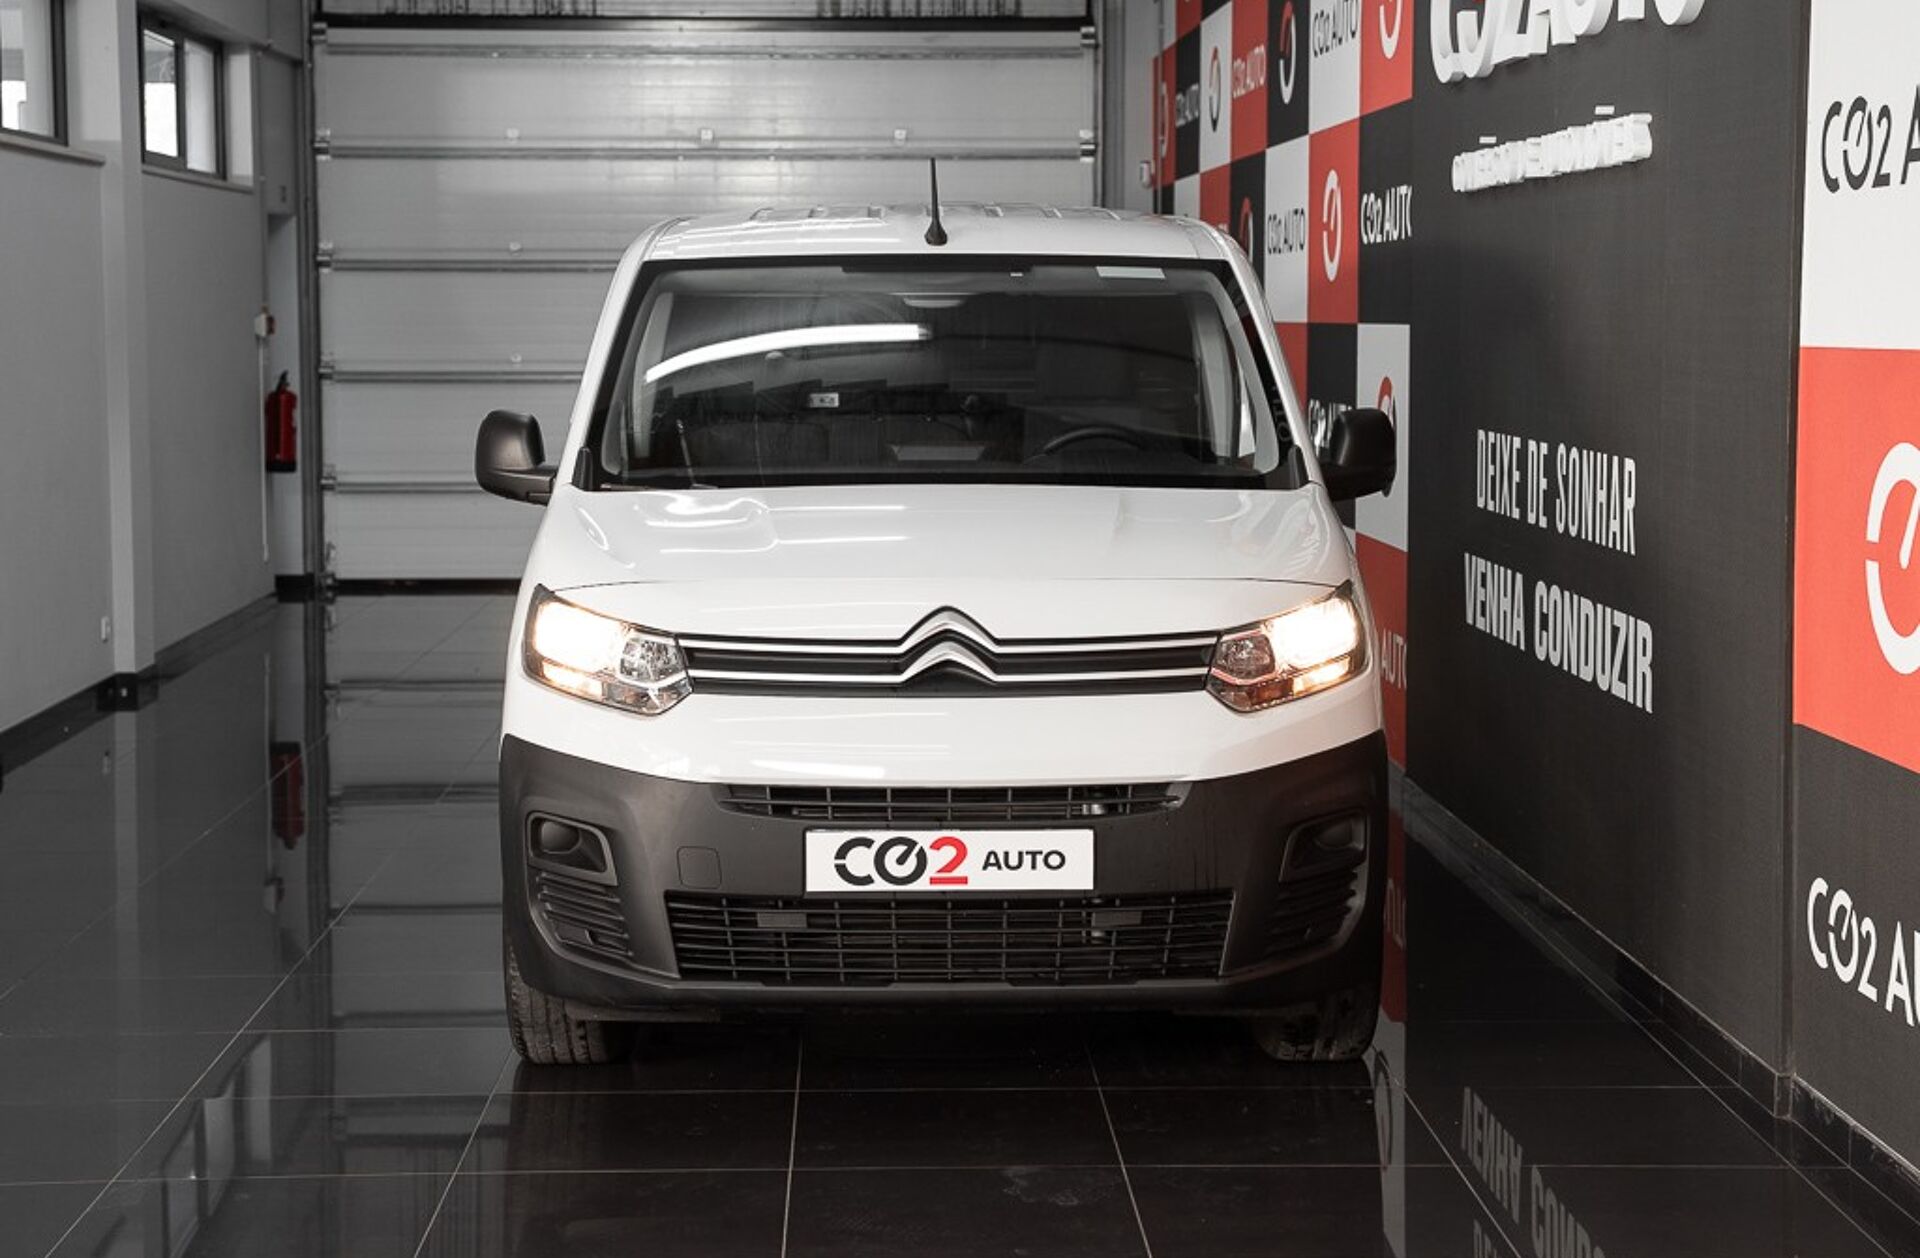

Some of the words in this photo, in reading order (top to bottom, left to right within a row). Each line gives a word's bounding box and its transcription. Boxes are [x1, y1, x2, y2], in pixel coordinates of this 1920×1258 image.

[1821, 95, 1891, 193] CO2
[1361, 192, 1382, 245] CO2
[1477, 429, 1521, 520] DEIXE
[1528, 439, 1548, 528] DE
[1556, 443, 1636, 556] SONHAR
[1464, 552, 1525, 651] VENHA
[1534, 580, 1653, 714] CONDUZIR
[834, 836, 968, 886] CO2
[982, 850, 1066, 871] AUTO
[1807, 877, 1878, 1002] CO2
[1886, 921, 1920, 1027] A
